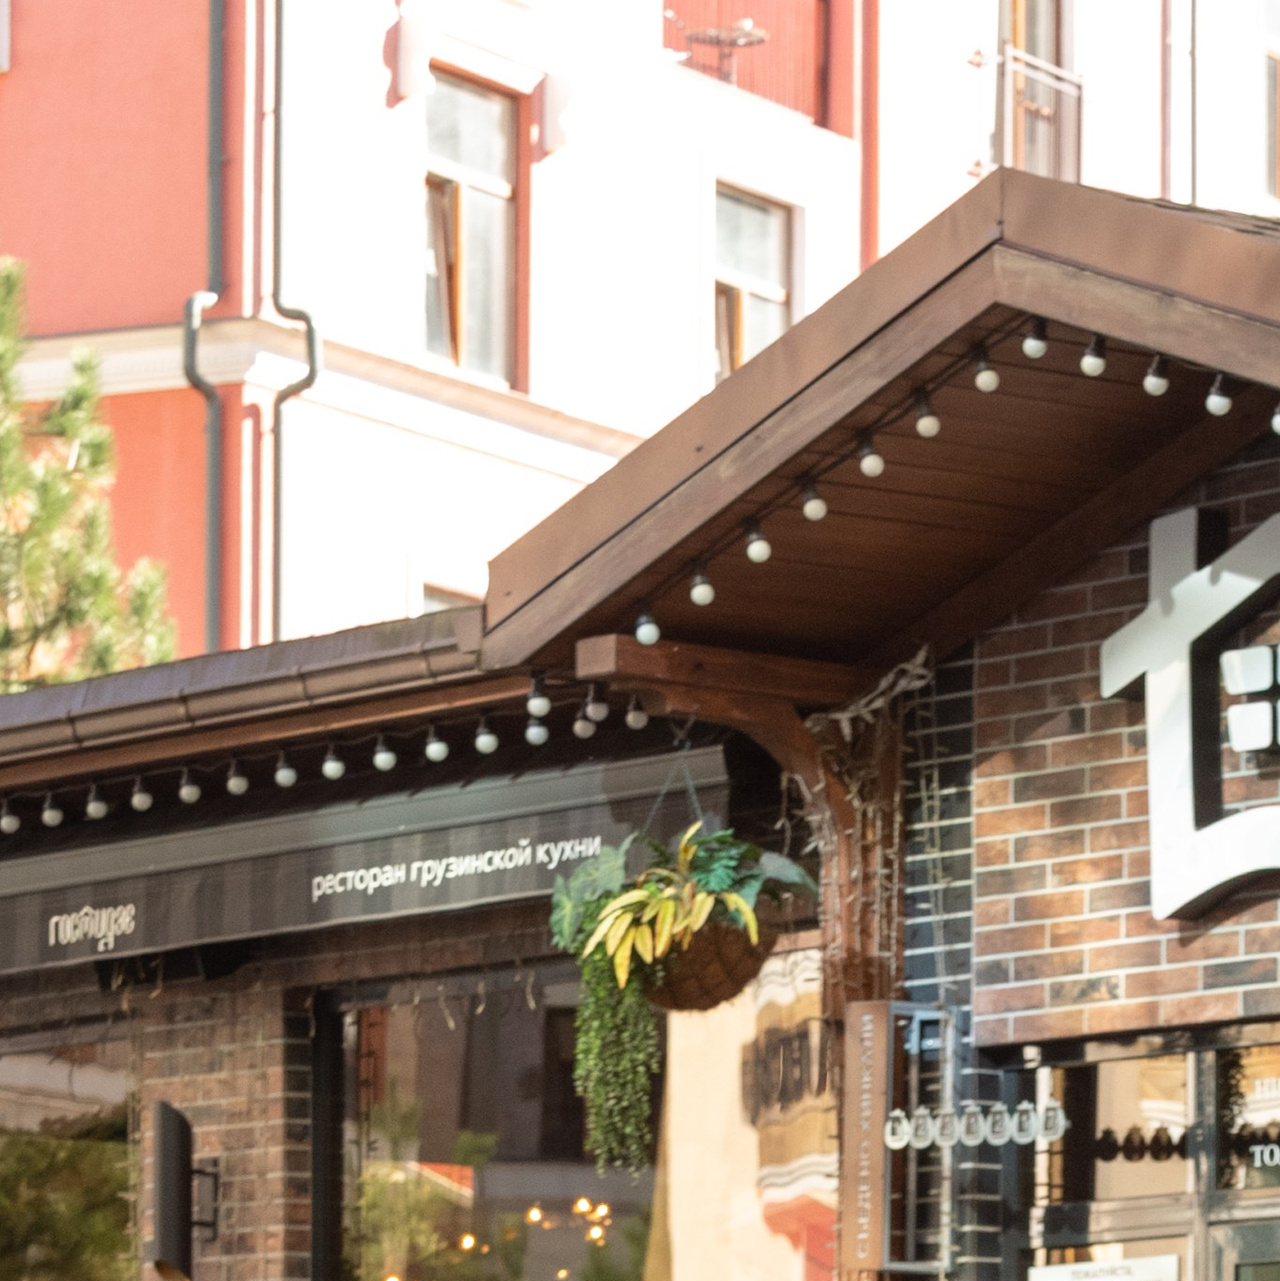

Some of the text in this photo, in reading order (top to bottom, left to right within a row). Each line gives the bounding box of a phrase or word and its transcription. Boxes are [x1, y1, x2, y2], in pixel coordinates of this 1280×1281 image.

[312, 835, 602, 903] ресторан грузинской кухни
